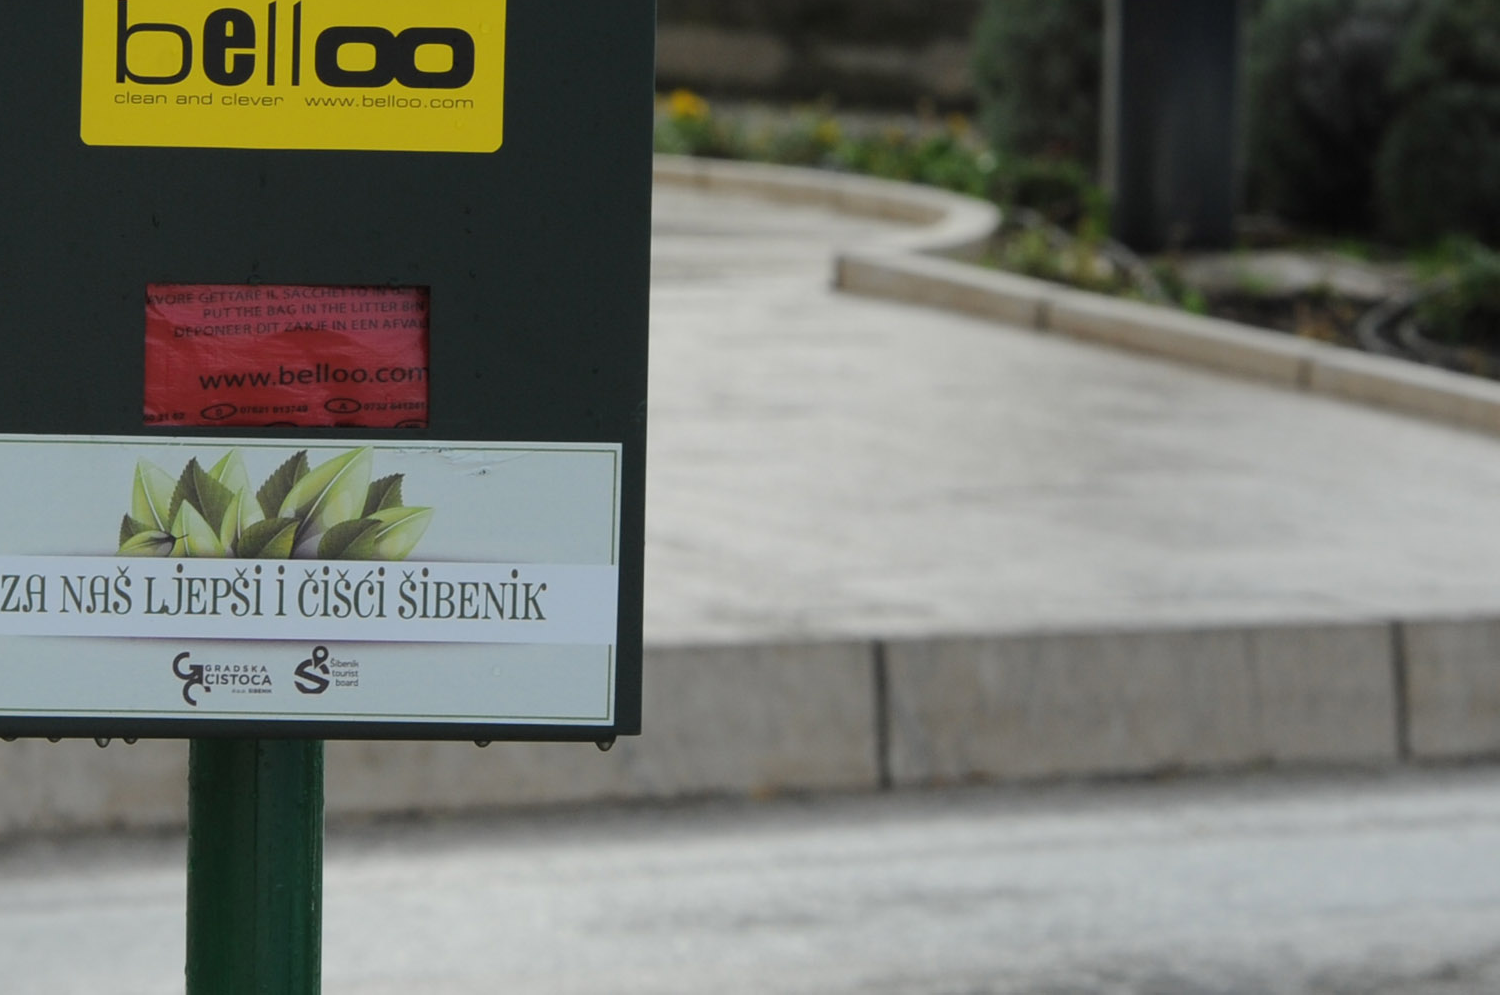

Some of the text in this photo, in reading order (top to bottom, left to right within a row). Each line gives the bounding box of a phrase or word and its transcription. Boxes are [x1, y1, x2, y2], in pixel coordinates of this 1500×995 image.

[113, 91, 285, 107] clean and clever
[304, 94, 475, 109] www.belloo.com
[203, 300, 425, 319] PUT THE BAG IN THE LITTER BIN
[173, 323, 252, 338] DEPONEER
[257, 322, 279, 335] DIT
[332, 319, 347, 331] IN
[352, 318, 378, 331] EEN
[0, 573, 48, 614] ZA
[59, 566, 132, 615] NAŠ
[397, 567, 548, 621] ŠIBENIK
[204, 664, 268, 673] GRADSKA
[335, 678, 359, 687] board
